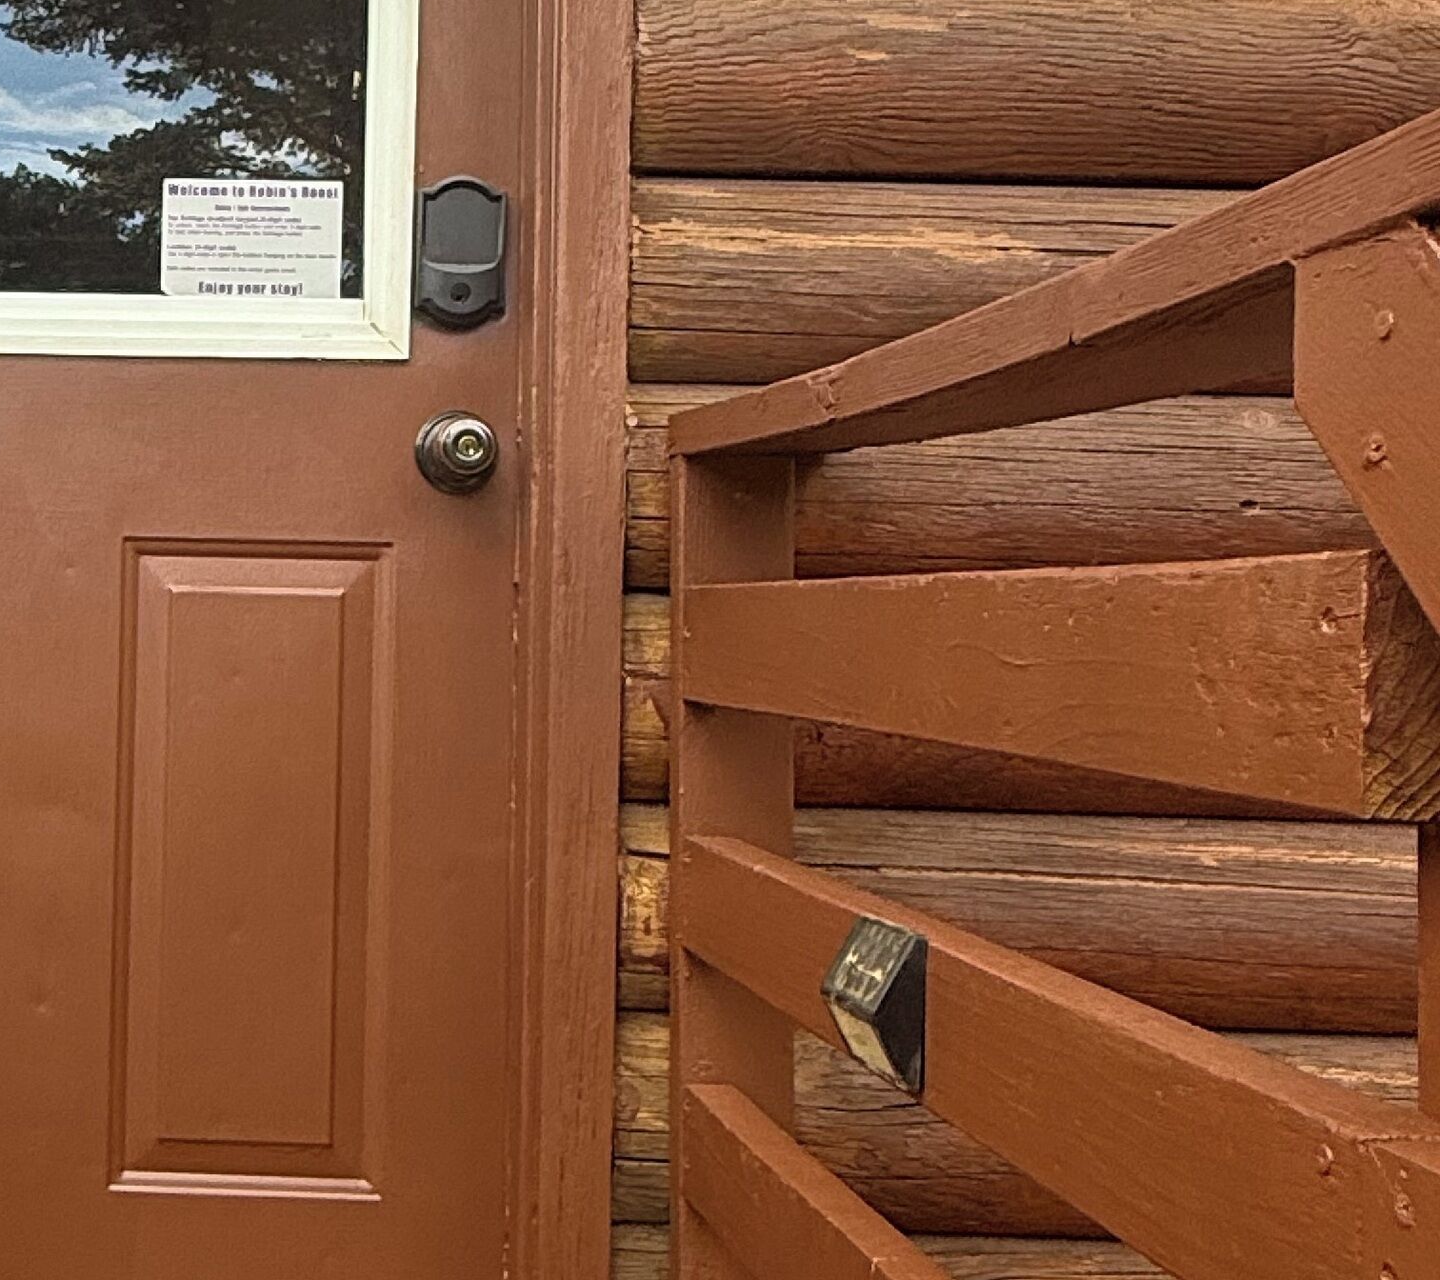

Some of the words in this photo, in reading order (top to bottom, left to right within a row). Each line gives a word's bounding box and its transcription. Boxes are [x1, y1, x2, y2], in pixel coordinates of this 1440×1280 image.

[168, 184, 228, 196] Welcome
[232, 186, 244, 197] to
[198, 281, 232, 295] Enjoy
[237, 283, 266, 295] your
[271, 282, 303, 296] stay!
